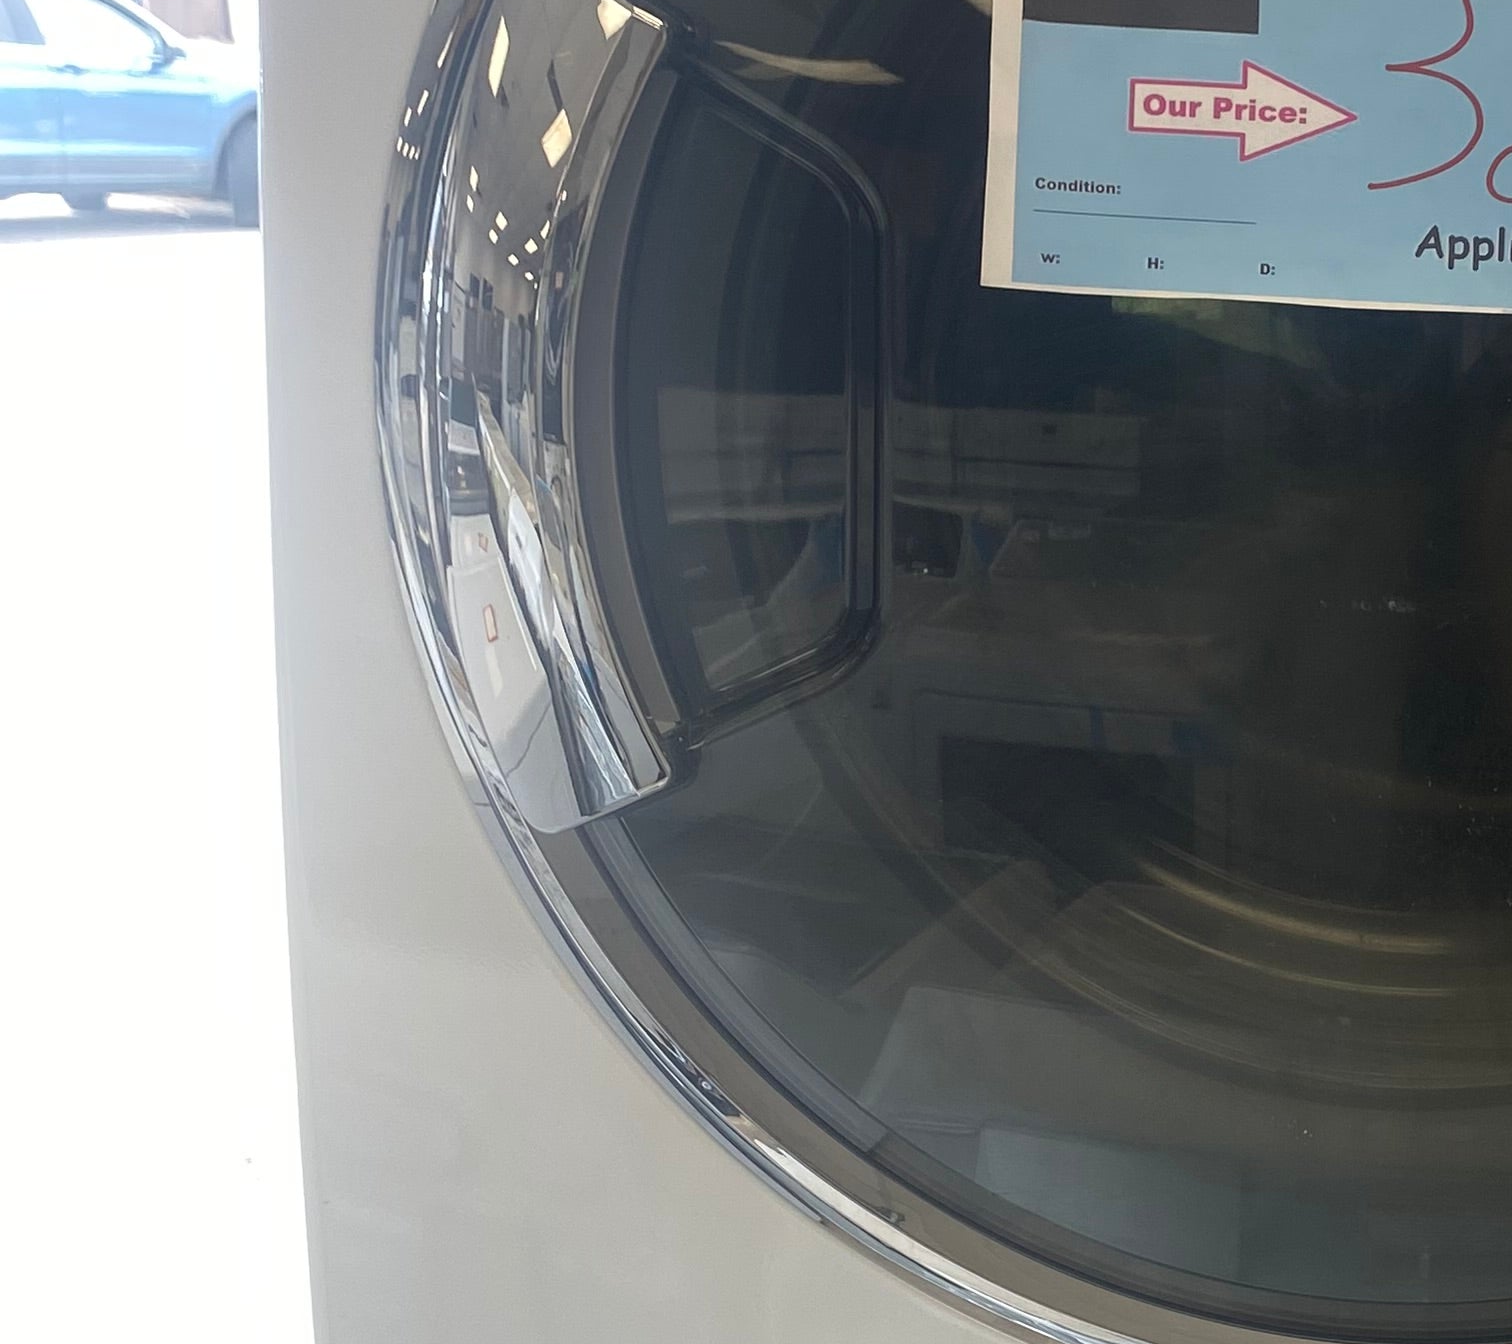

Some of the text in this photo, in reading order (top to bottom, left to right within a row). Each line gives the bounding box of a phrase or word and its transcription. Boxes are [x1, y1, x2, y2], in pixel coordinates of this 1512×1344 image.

[1143, 95, 1308, 125] Our Price:
[1035, 177, 1121, 195] Condition:
[1147, 258, 1164, 270] H:
[1260, 263, 1275, 276] D:
